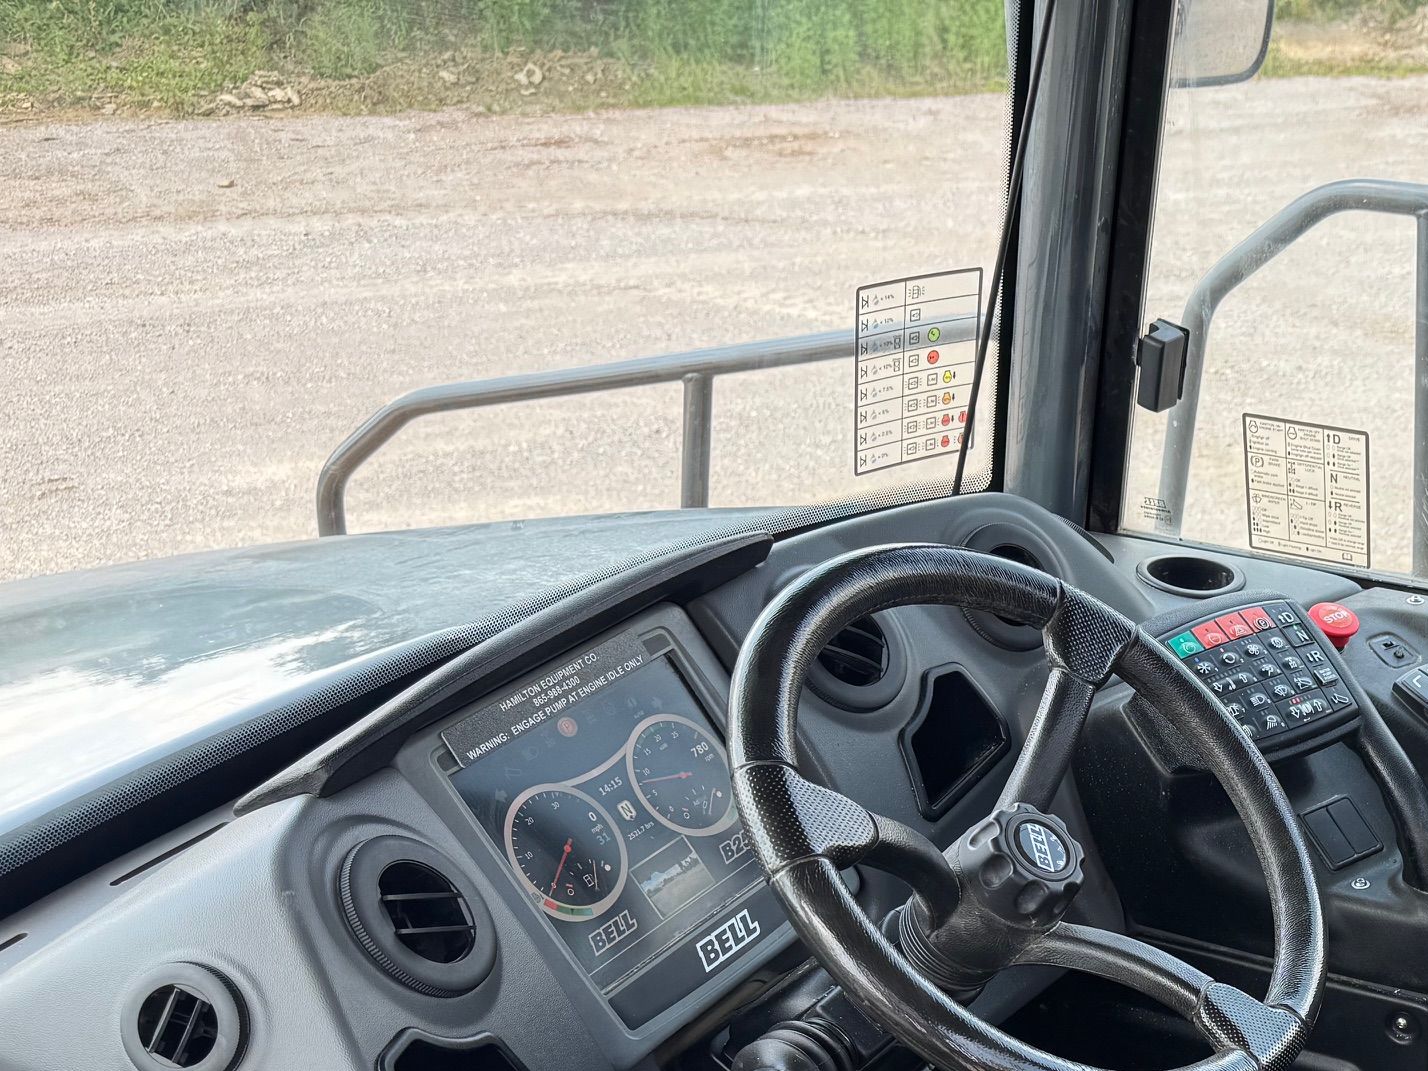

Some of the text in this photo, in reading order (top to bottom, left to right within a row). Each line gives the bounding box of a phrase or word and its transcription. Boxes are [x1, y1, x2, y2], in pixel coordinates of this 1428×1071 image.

[1332, 434, 1341, 445] D
[1330, 473, 1338, 484] N
[1334, 501, 1343, 512] R
[1323, 609, 1351, 624] STOP
[1296, 629, 1309, 642] N
[499, 653, 600, 712] HAMILTON EQUIPMENT CO.
[533, 675, 580, 707] 865-988-4300
[466, 654, 644, 760] WARNING: ENGAGE PUMP AT ENGINE IDLE ONLY
[690, 741, 710, 758] 780
[642, 767, 650, 776] 10
[599, 776, 623, 796] 14:15
[551, 801, 560, 810] 30
[525, 817, 535, 826] 20
[588, 811, 597, 822] 0
[591, 823, 604, 833] mph
[1027, 823, 1055, 873] BELL
[524, 851, 534, 859] 10
[588, 909, 638, 956] BELL
[696, 908, 761, 973] BELL
